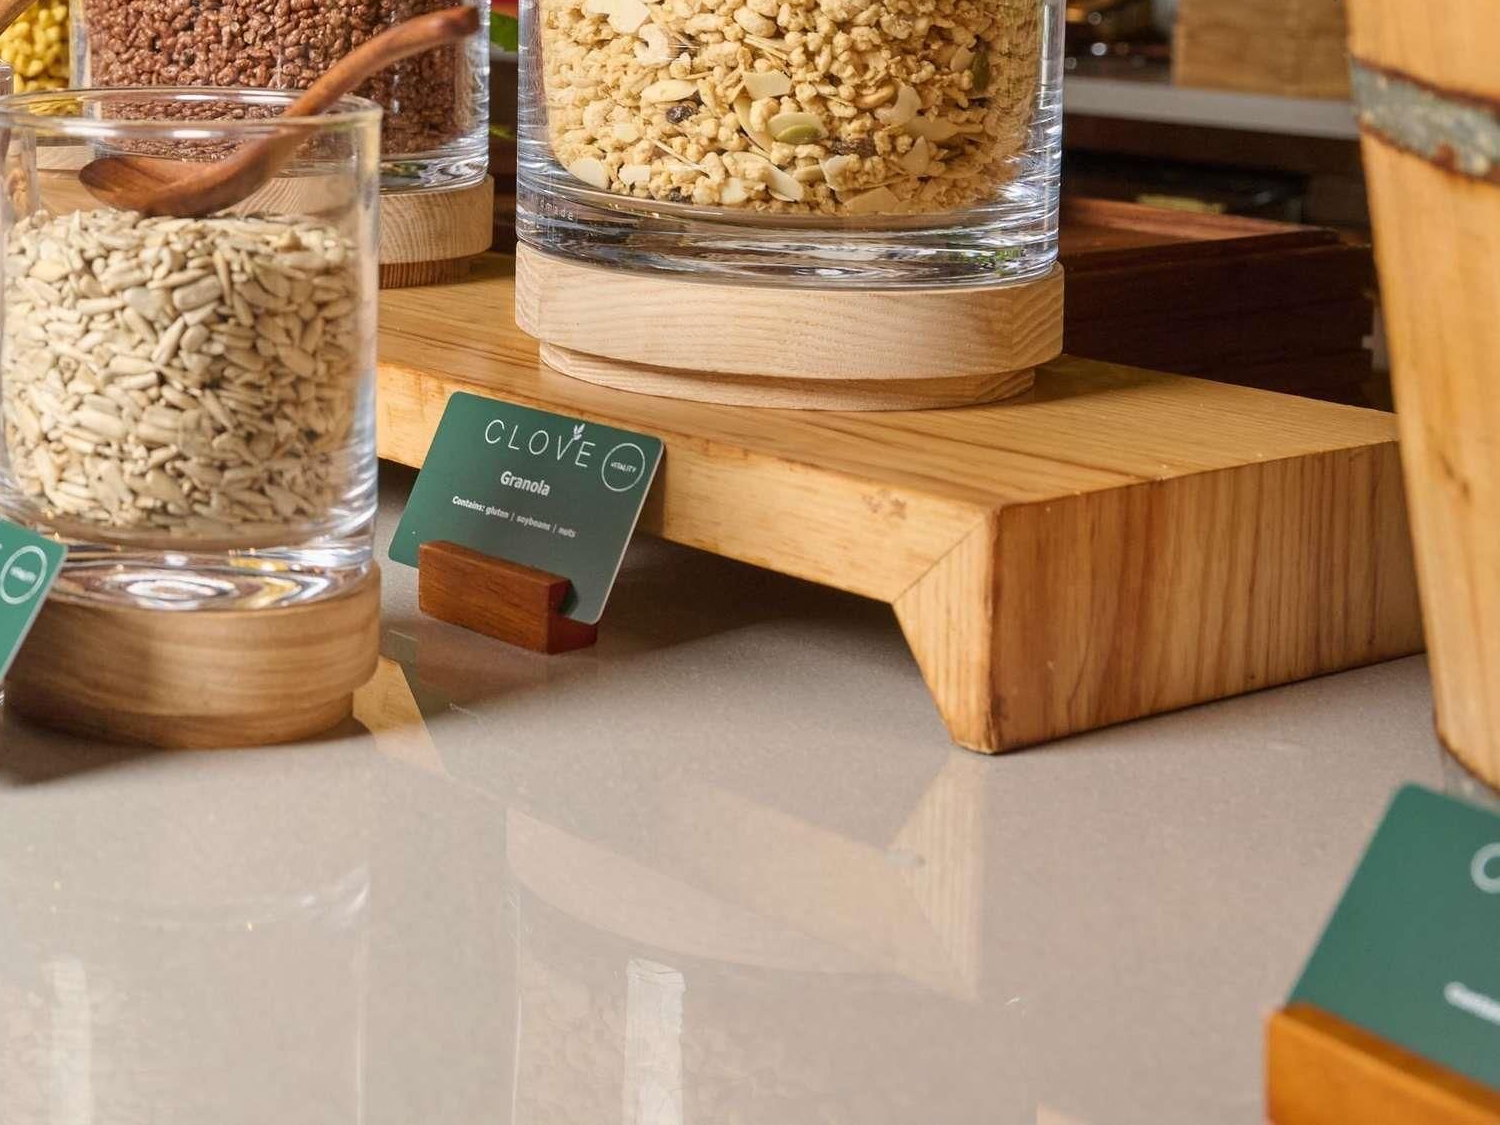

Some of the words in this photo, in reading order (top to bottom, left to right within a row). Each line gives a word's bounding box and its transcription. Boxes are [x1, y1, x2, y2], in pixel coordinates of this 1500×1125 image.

[484, 419, 597, 467] CLOVE
[500, 470, 551, 497] Granola
[452, 495, 485, 512] Contains:
[485, 506, 509, 519] gluten
[516, 515, 551, 531] soybeans
[558, 527, 577, 538] nuts
